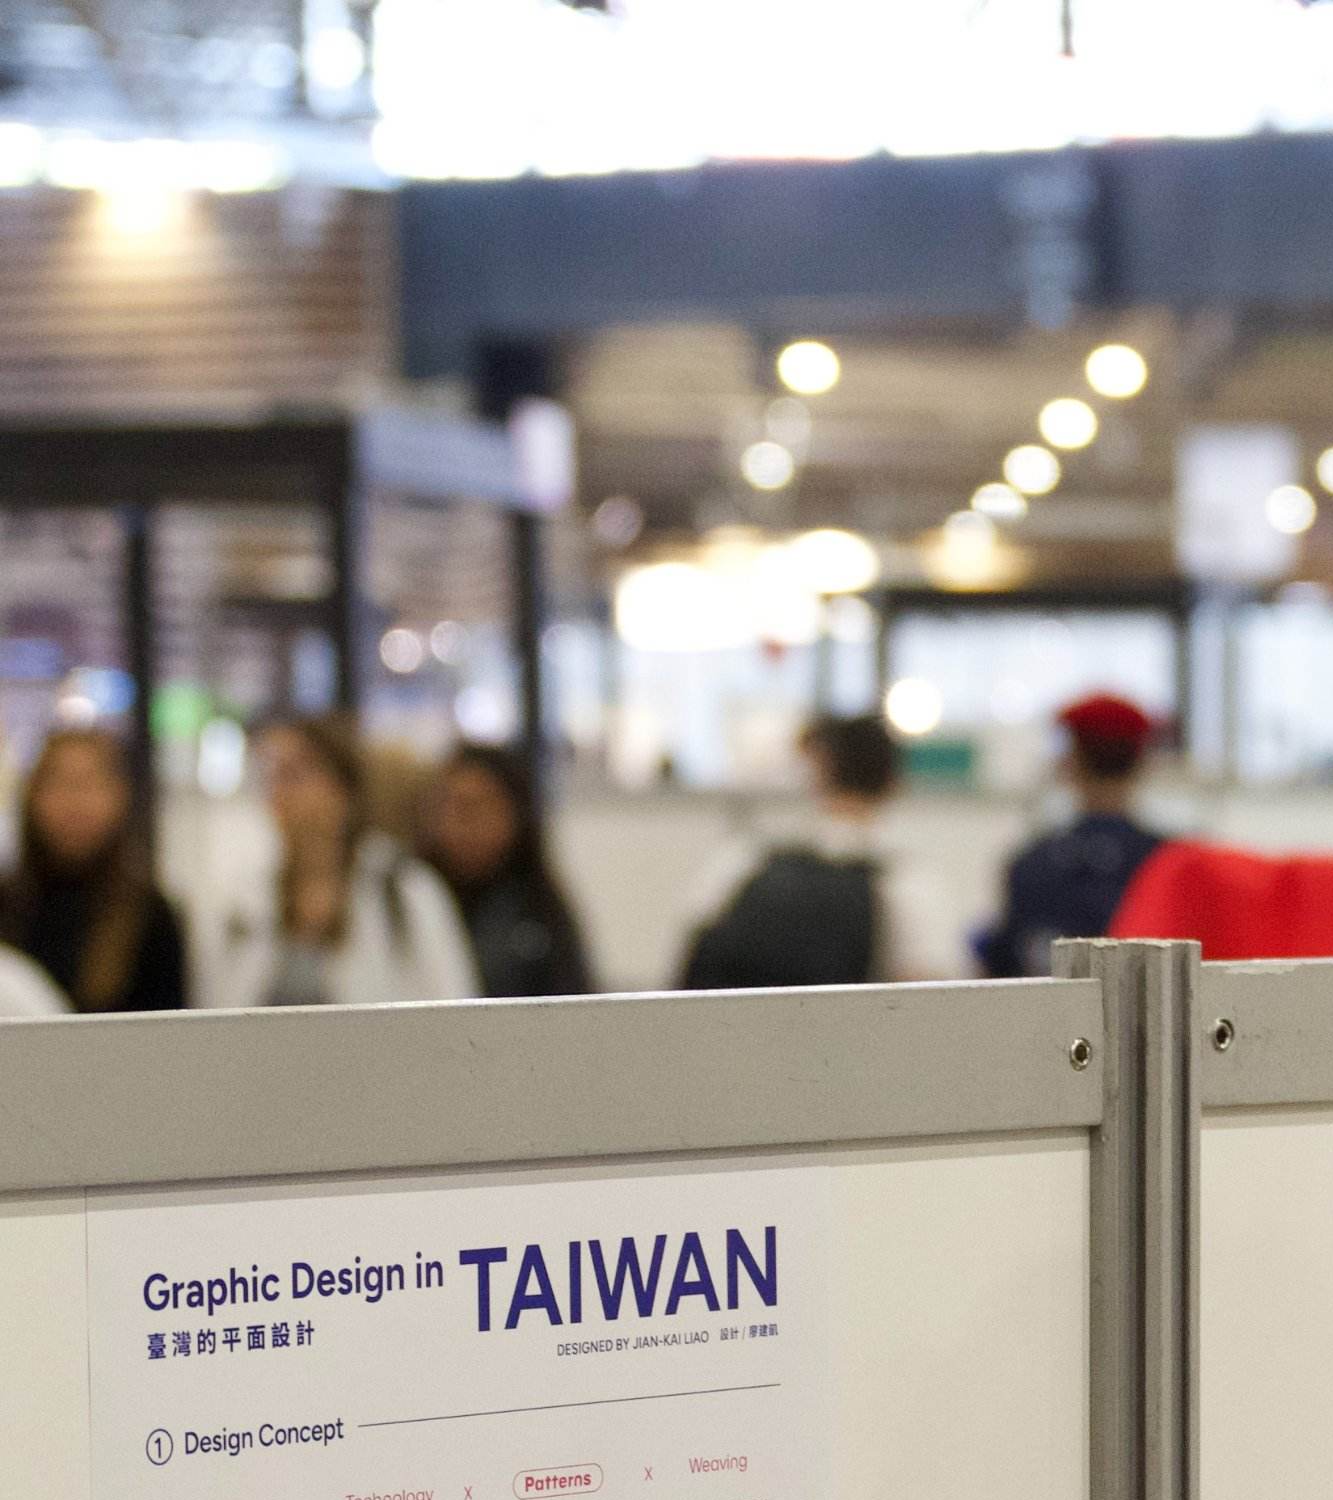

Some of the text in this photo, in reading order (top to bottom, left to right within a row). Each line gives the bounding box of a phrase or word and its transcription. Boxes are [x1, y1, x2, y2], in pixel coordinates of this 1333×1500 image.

[144, 1226, 779, 1332] Graphic Design in TAIWAN
[148, 1319, 315, 1359] 臺灣的平面設計
[557, 1330, 710, 1356] DESIGNED BY JIAN-KAI LIAO
[185, 1427, 253, 1456] Design
[259, 1417, 344, 1447] Concept
[525, 1473, 592, 1492] Patterns
[689, 1454, 748, 1473] Weaving
